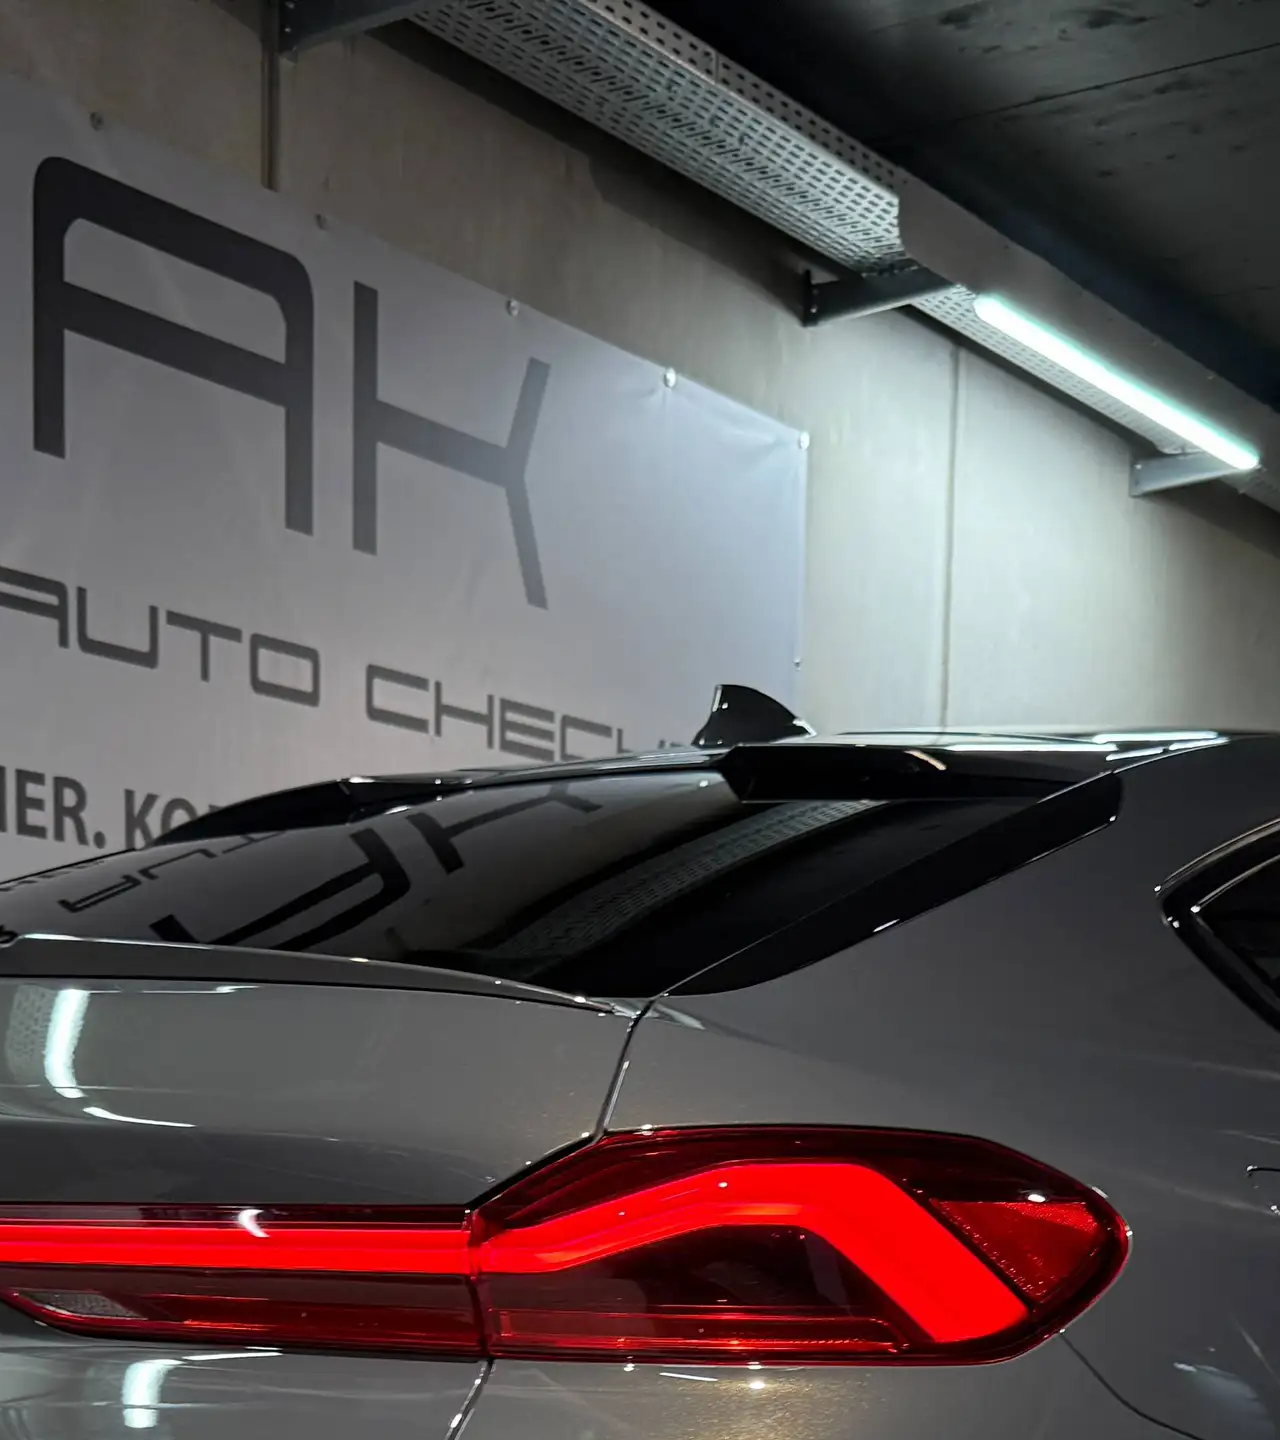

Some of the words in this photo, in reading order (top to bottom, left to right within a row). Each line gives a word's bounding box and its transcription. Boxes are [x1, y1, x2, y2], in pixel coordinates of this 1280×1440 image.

[32, 156, 550, 610] AK
[365, 663, 686, 762] CHEC
[123, 789, 232, 850] KO
